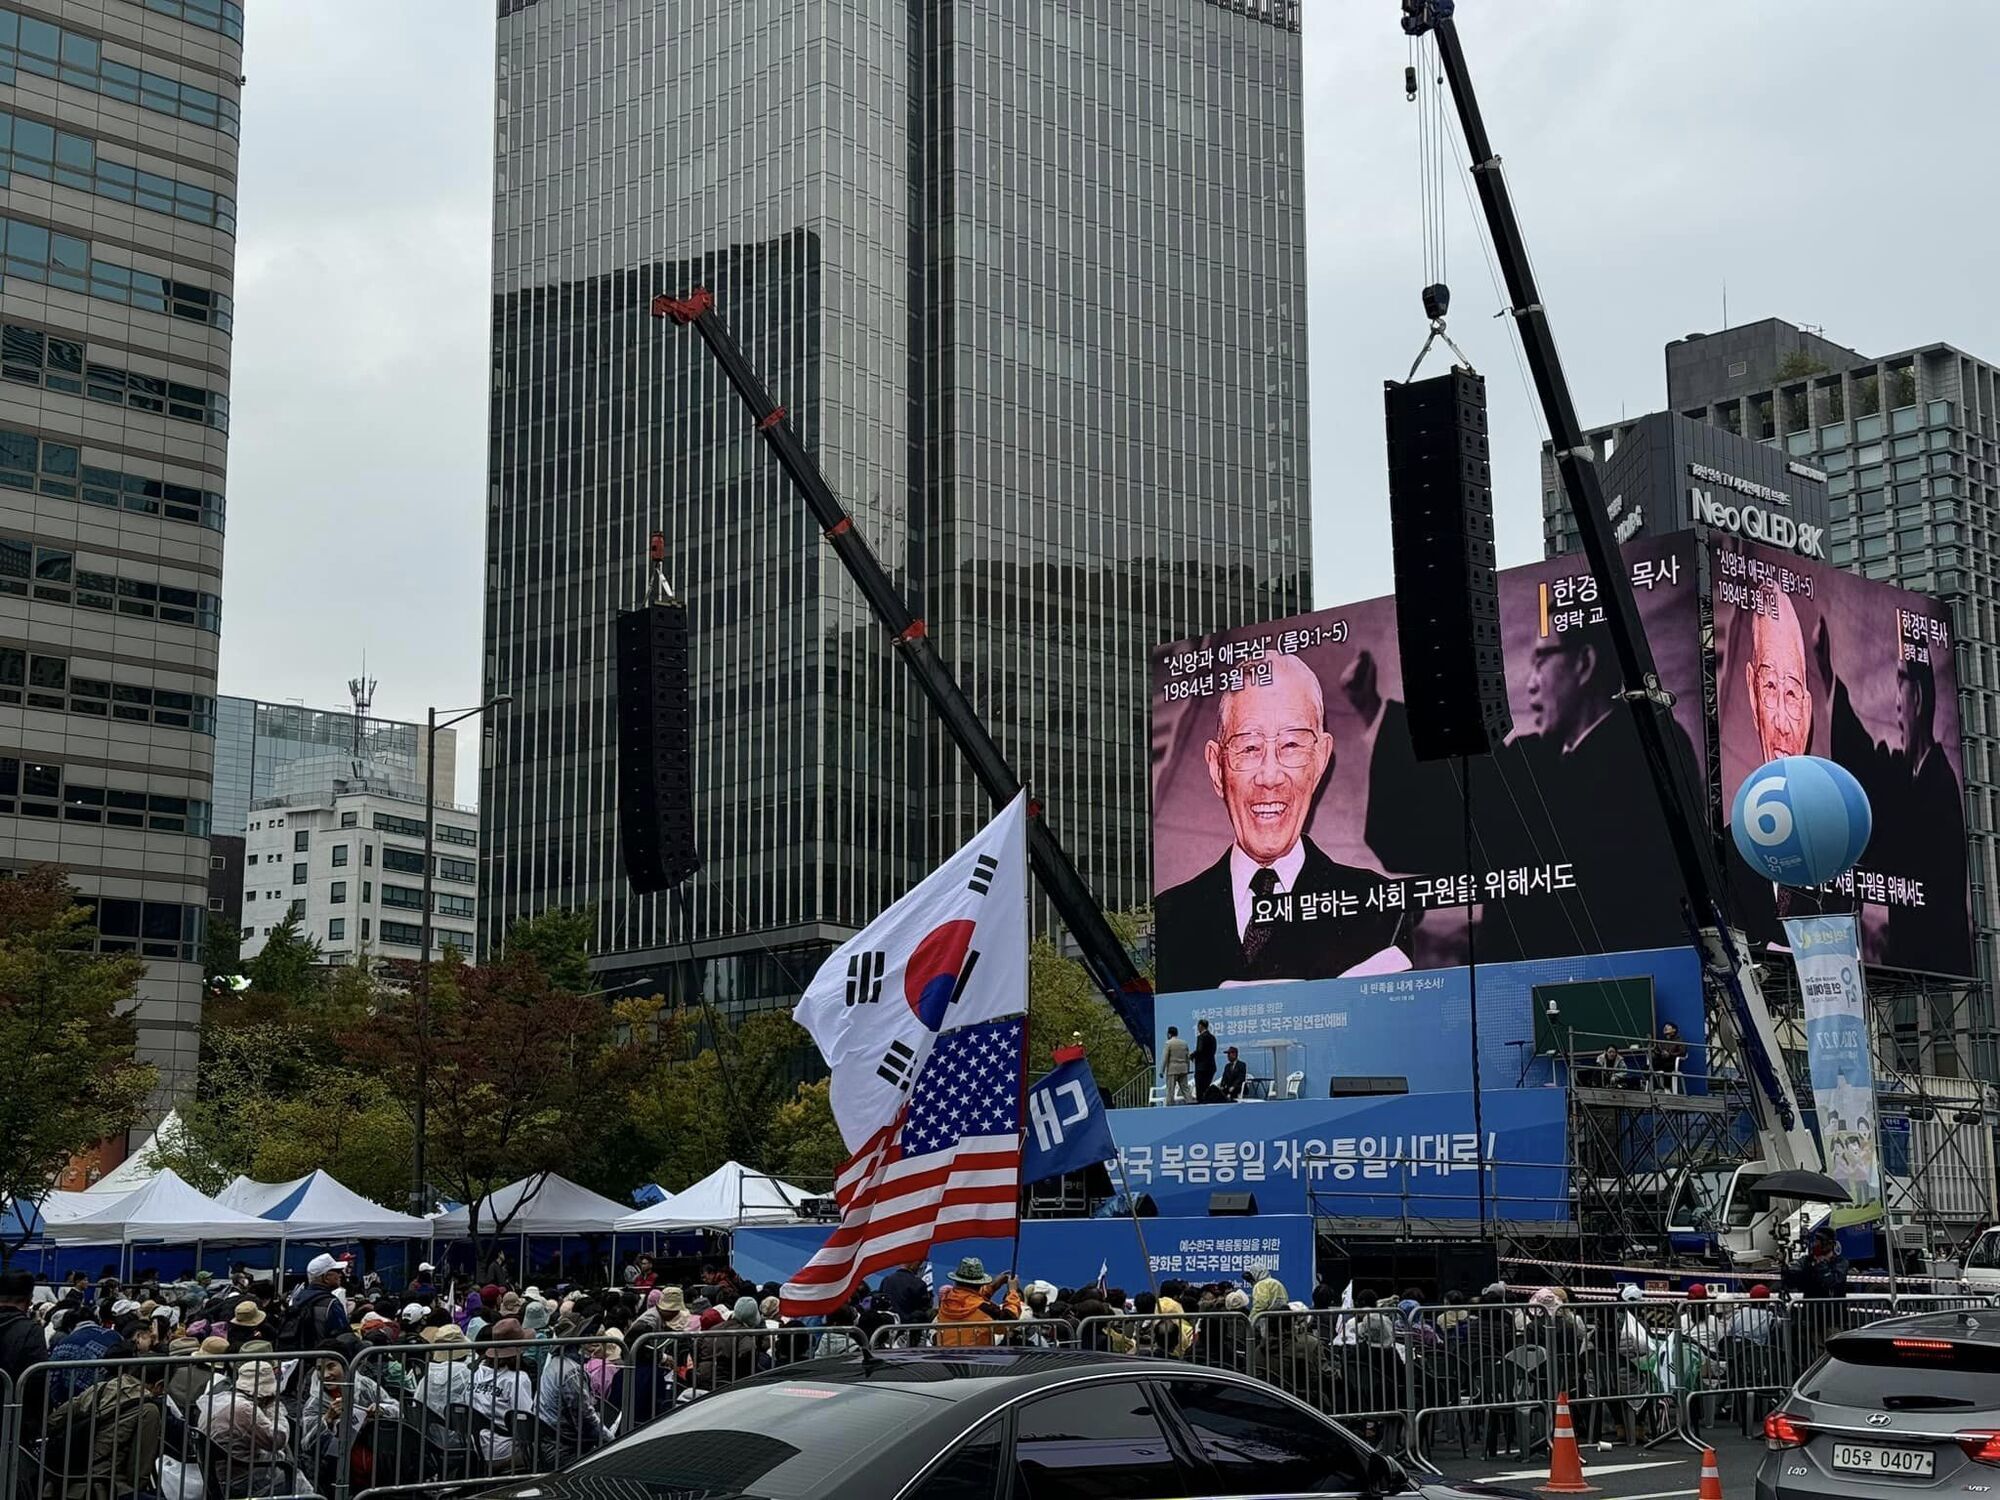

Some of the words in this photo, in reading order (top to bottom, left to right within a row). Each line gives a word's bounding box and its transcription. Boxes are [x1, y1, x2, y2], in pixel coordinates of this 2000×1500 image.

[1691, 487, 1741, 532] Neo
[1742, 505, 1798, 549] QLED
[1798, 522, 1825, 560] 8K
[1553, 574, 1598, 607] 한경
[1631, 554, 1681, 590] 목사
[1718, 581, 1749, 610] 1984년
[1750, 589, 1764, 615] 3월
[1765, 594, 1779, 619] 1일
[1277, 621, 1349, 655] (롬9:1~5)
[1554, 609, 1584, 632] 영락
[1589, 607, 1608, 624] 교
[1901, 610, 1929, 643] 한경직
[1930, 618, 1948, 649] 목사
[1164, 673, 1214, 701] 1984년
[1219, 666, 1244, 692] 3월
[1250, 662, 1273, 686] 1일
[1744, 776, 1793, 846] 6
[1254, 896, 1293, 923] 요새
[1300, 889, 1359, 921] 말하는
[1365, 883, 1406, 912] 사회
[1413, 874, 1477, 908] 구원을
[1484, 863, 1577, 899] 위해서도
[1857, 871, 1886, 902] 구원을
[1888, 876, 1926, 907] 위해서도
[1360, 983, 1368, 995] 내
[1370, 981, 1394, 994] 민족을
[1396, 979, 1413, 992] 내게
[1415, 977, 1445, 990] 주소서!
[1226, 1019, 1258, 1035] 광화문
[1260, 1011, 1348, 1033] 전국주일연합예배
[1159, 1140, 1266, 1184] 복음통일
[1272, 1132, 1496, 1181] 자유통일시대로!
[1149, 1255, 1182, 1272] 광화문
[1179, 1239, 1214, 1252] 예수한국
[1216, 1238, 1260, 1252] 복음통일을
[1262, 1238, 1280, 1251] 위한
[1842, 1448, 1872, 1466] 05우
[1880, 1451, 1924, 1470] 0407
